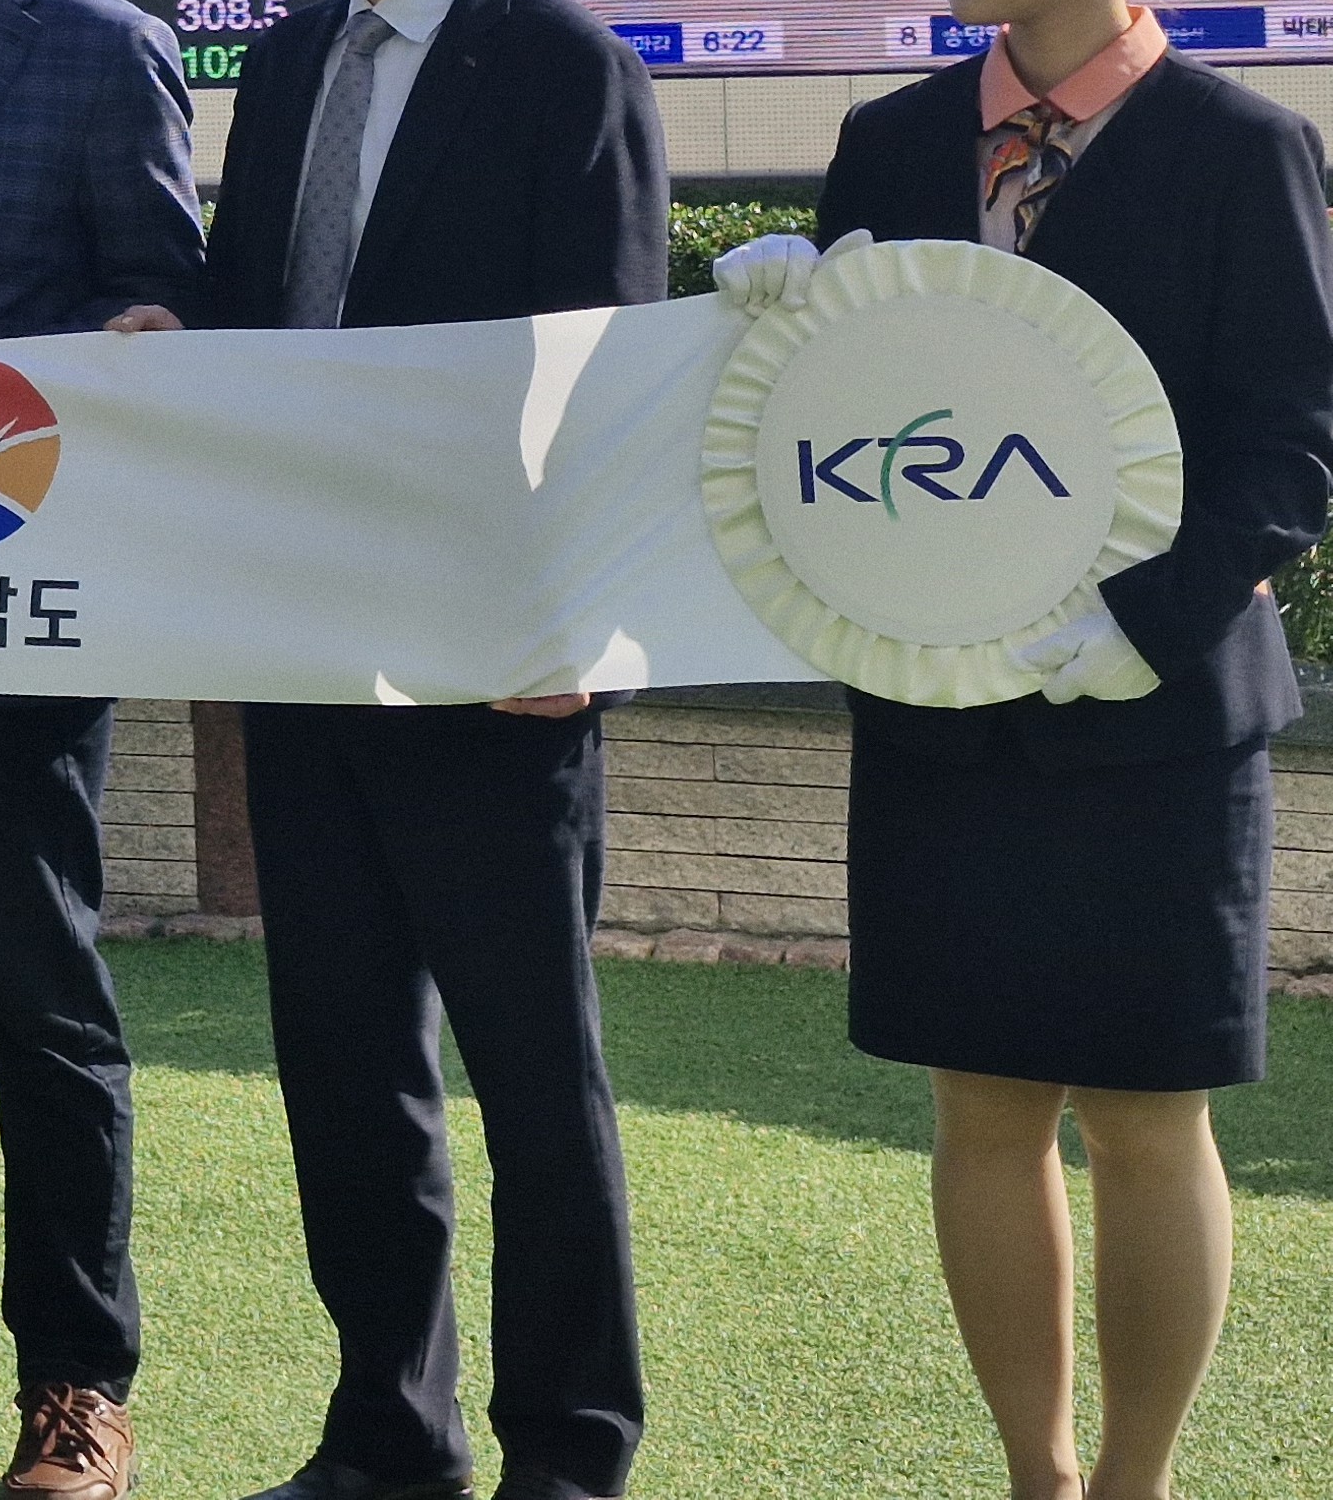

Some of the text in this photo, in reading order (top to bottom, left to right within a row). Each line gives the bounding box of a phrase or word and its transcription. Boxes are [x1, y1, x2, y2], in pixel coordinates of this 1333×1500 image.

[900, 26, 917, 46] 8
[1283, 15, 1333, 38] 박태
[703, 30, 765, 51] 6:22
[796, 409, 1073, 518] KRA
